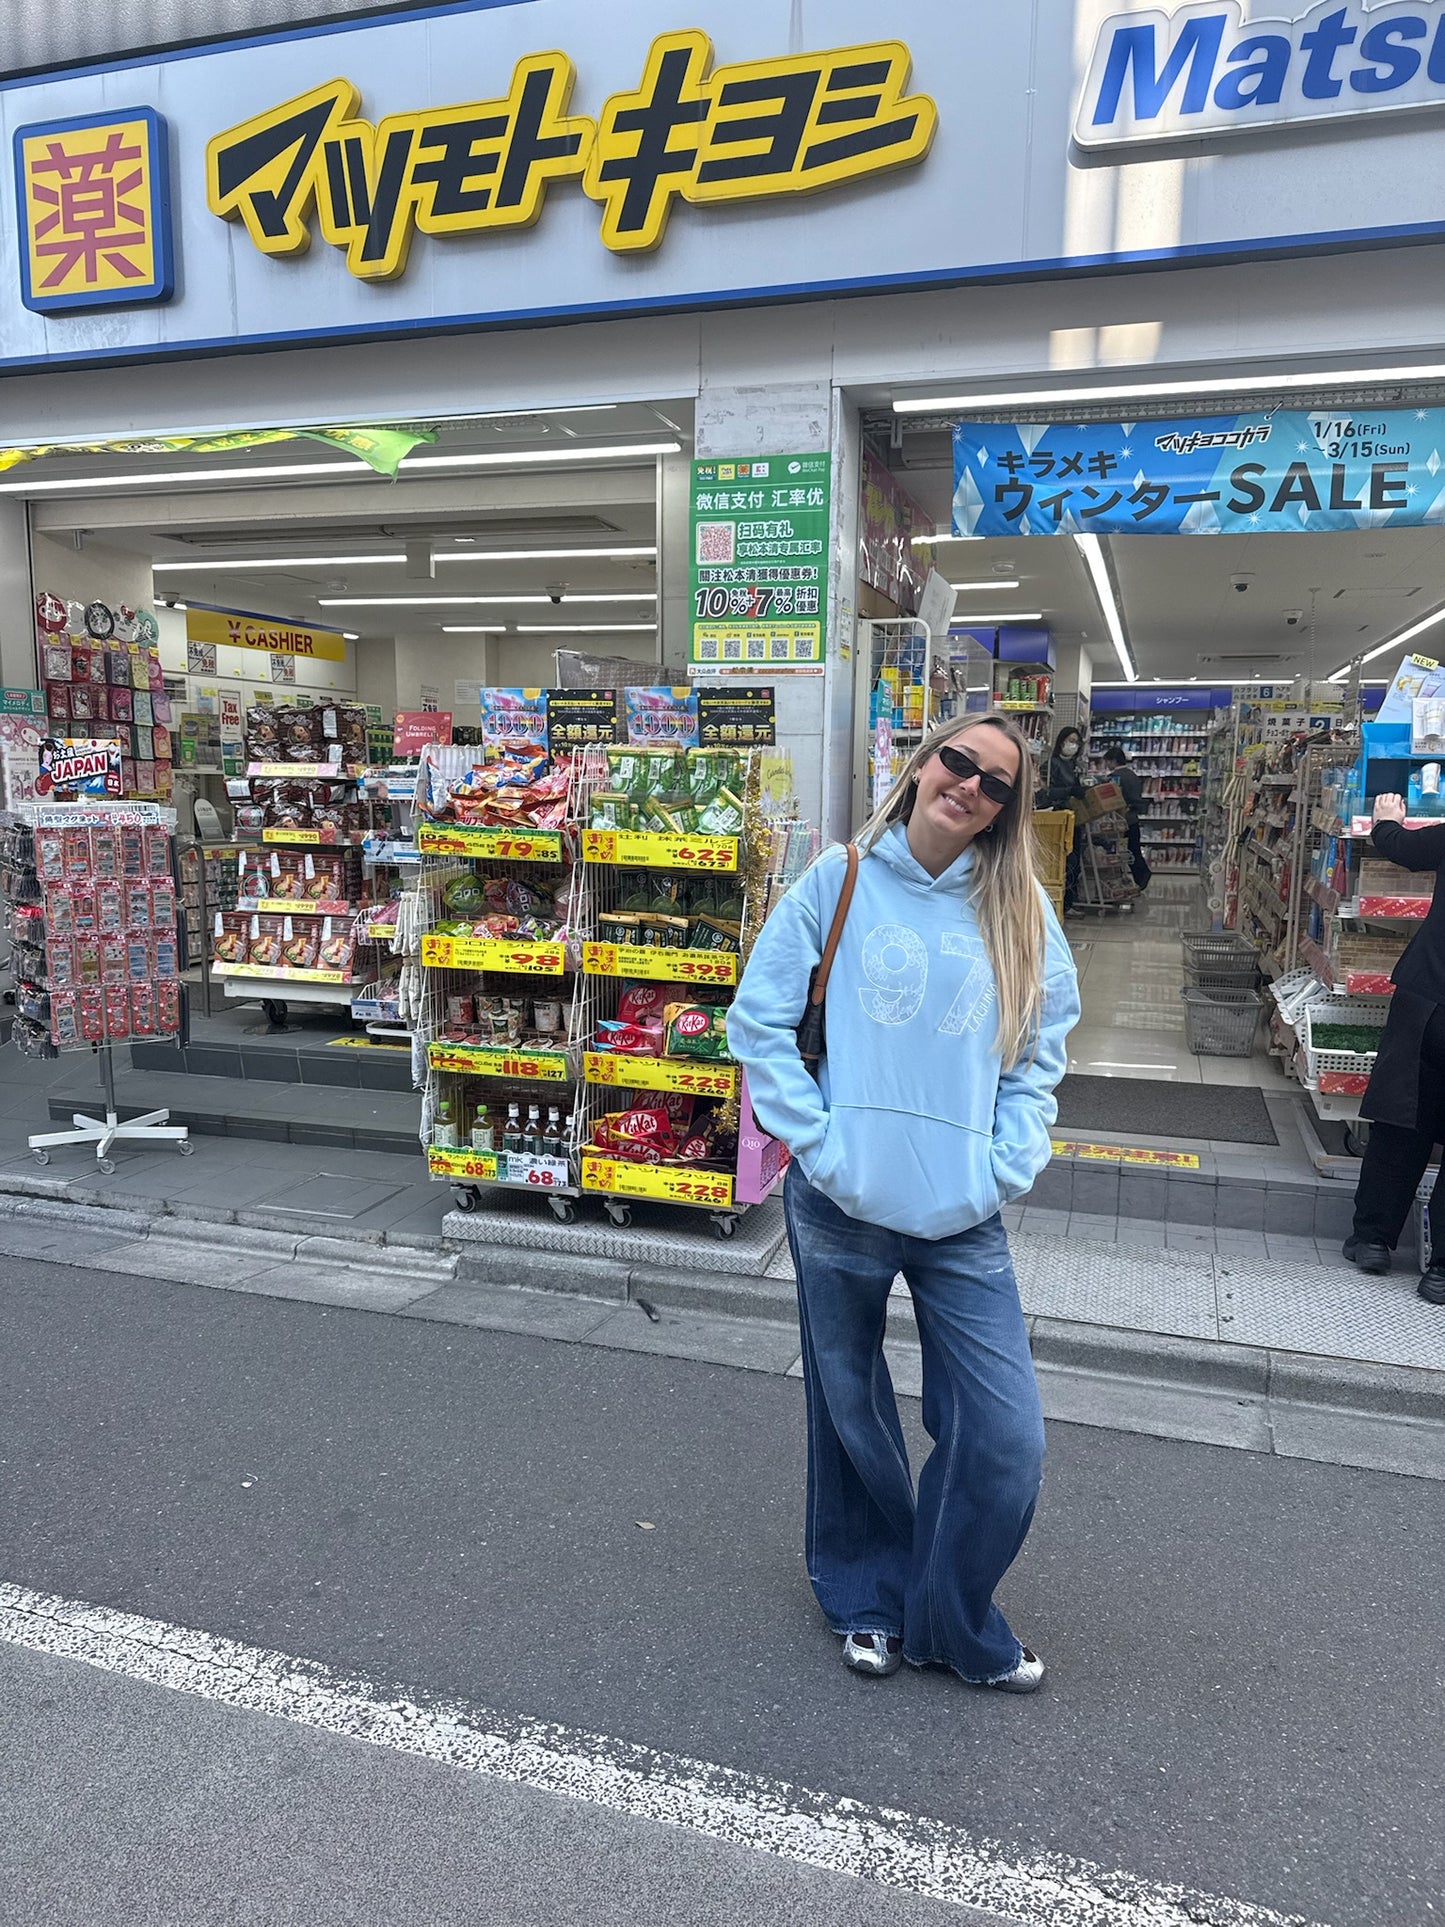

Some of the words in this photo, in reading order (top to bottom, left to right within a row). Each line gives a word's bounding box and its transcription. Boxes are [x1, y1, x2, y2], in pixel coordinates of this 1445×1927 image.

[1092, 7, 1445, 125] Mats
[218, 48, 917, 263] マツモトキヨシ
[31, 133, 148, 286] 薬
[1313, 421, 1386, 438] 1/16(Fri)
[1156, 426, 1271, 453] マツキヨココカラ
[997, 451, 1118, 479] キラメキ
[1227, 462, 1409, 514] SALE
[696, 490, 764, 510] 微信支付
[771, 488, 824, 507] 汇率优
[738, 520, 793, 539] 扫码有礼
[737, 541, 822, 556] 享松本清专属汇率
[796, 587, 818, 599] 折扣
[796, 601, 818, 613] 優惠
[245, 625, 314, 654] CASHIER
[1413, 656, 1435, 668] NEW
[1156, 696, 1189, 704] シャンプー
[1263, 688, 1270, 697] 6
[223, 700, 238, 713] Tax
[222, 713, 240, 726] Free
[551, 723, 613, 740] 全額還元
[703, 723, 772, 741] 全額還元
[53, 754, 106, 780] JAPAN
[678, 848, 733, 862] 625
[511, 953, 560, 966] 98
[679, 963, 732, 976] 398
[858, 923, 996, 1035] 97
[680, 1015, 704, 1031] KitKat
[607, 1032, 636, 1045] KitKat
[679, 1075, 731, 1089] 228
[620, 1114, 657, 1134] KitKat
[466, 1162, 484, 1175] 68
[528, 1170, 553, 1185] 68
[676, 1182, 728, 1197] 228
